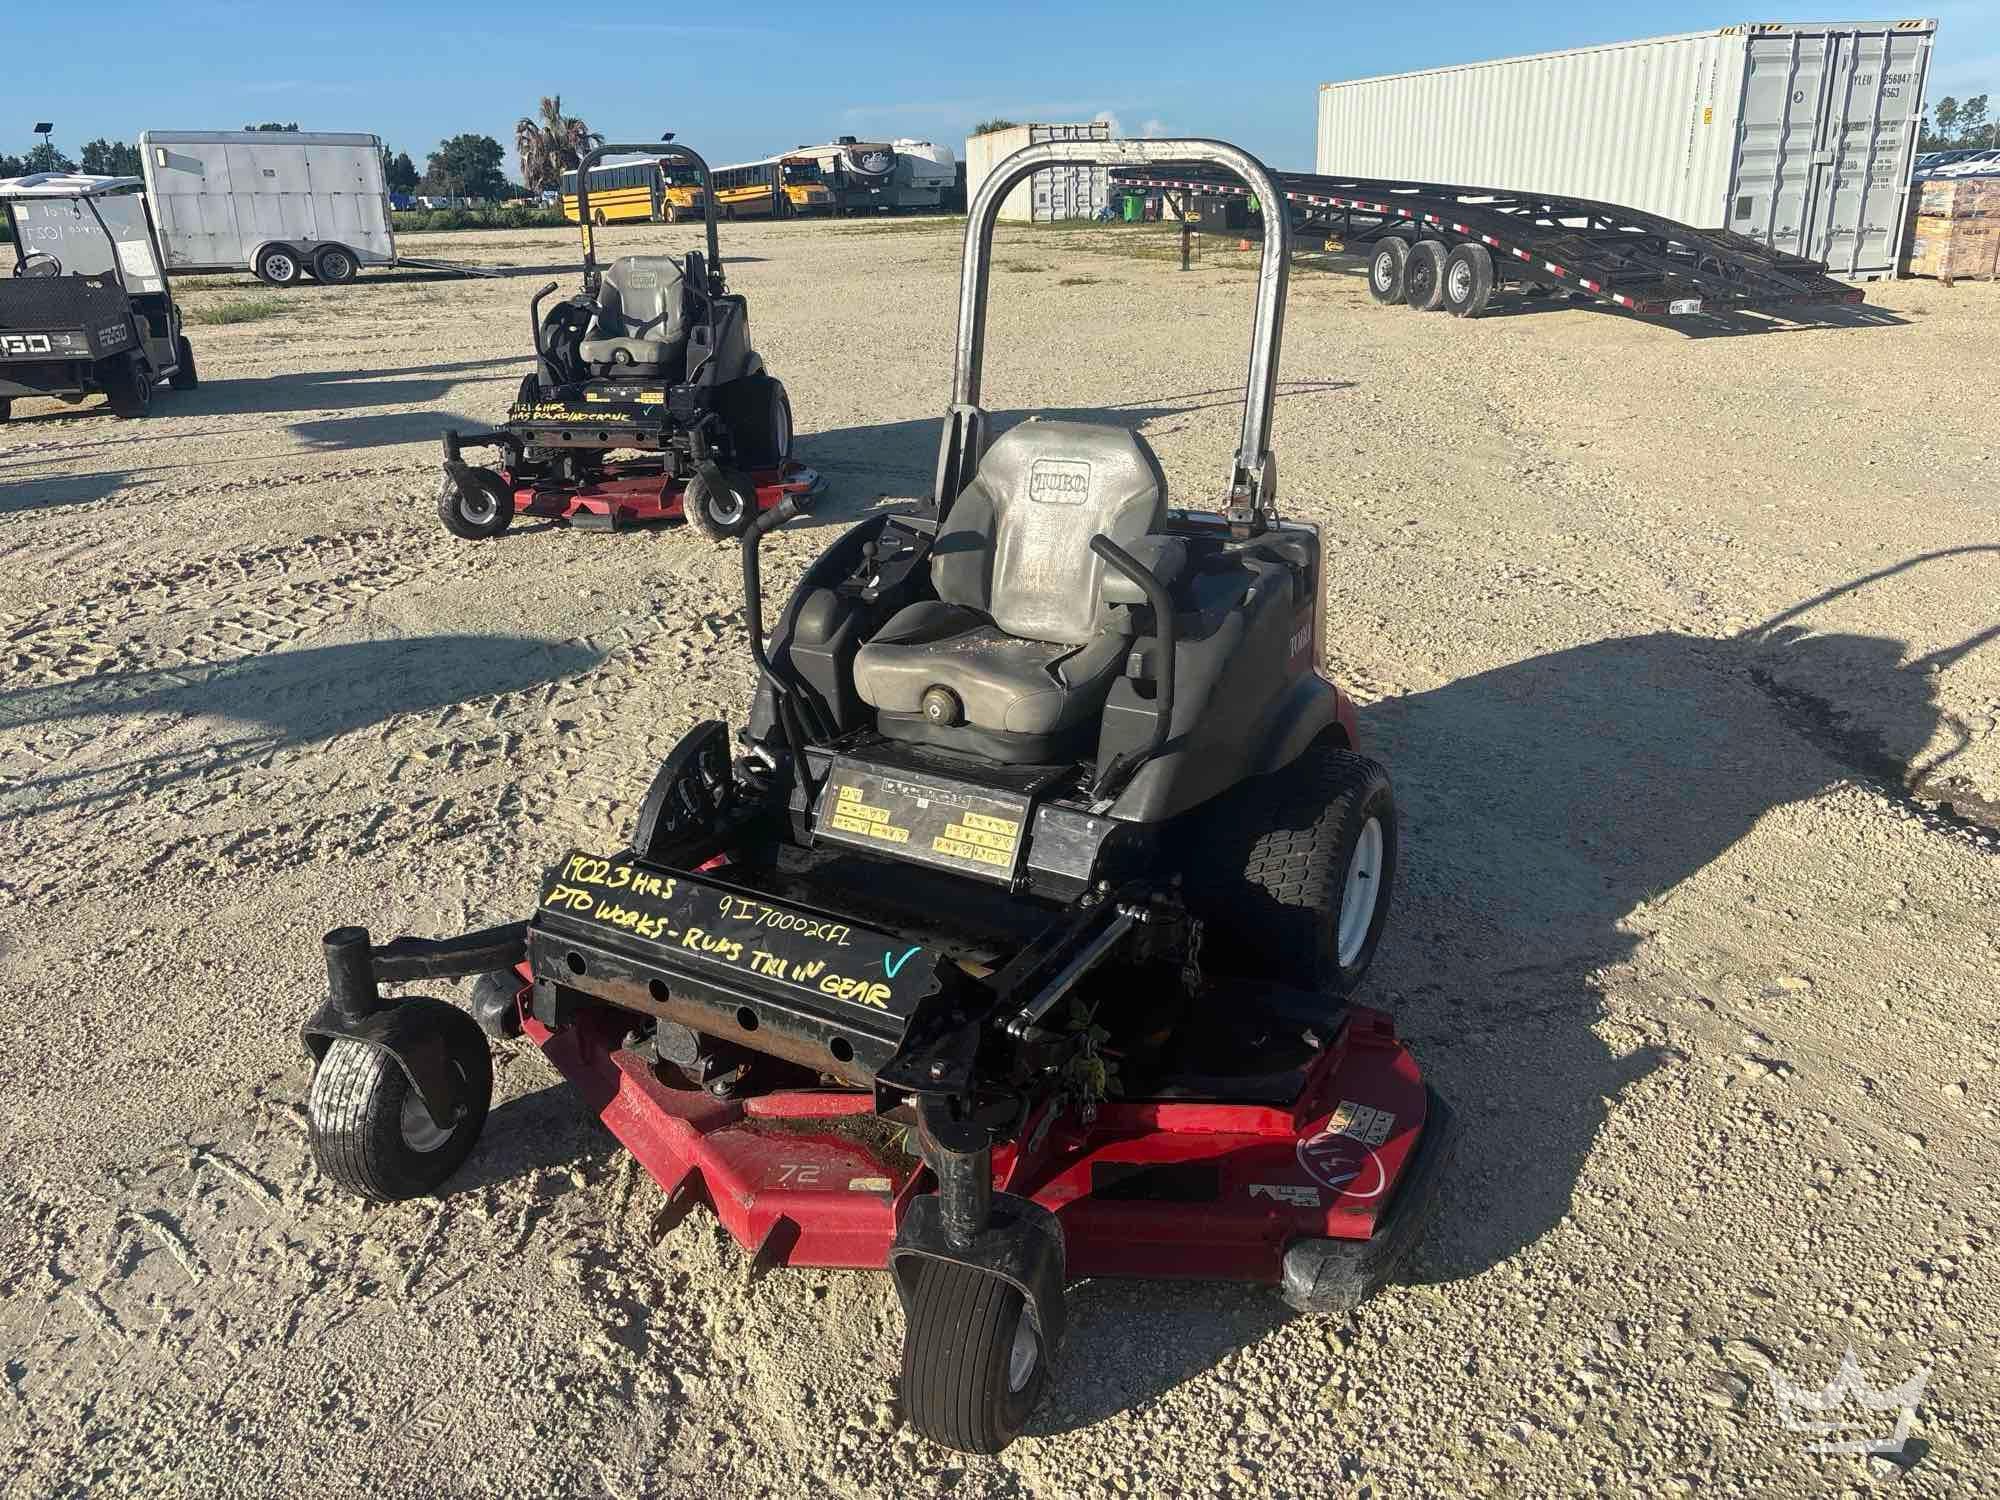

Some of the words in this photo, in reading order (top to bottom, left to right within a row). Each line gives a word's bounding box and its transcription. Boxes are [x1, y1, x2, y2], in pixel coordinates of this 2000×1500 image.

[562, 853, 632, 889] 1902.3
[631, 872, 677, 900] HRS
[544, 883, 594, 911] PTO
[594, 900, 669, 940] WORKS
[819, 973, 892, 1010] GEAR
